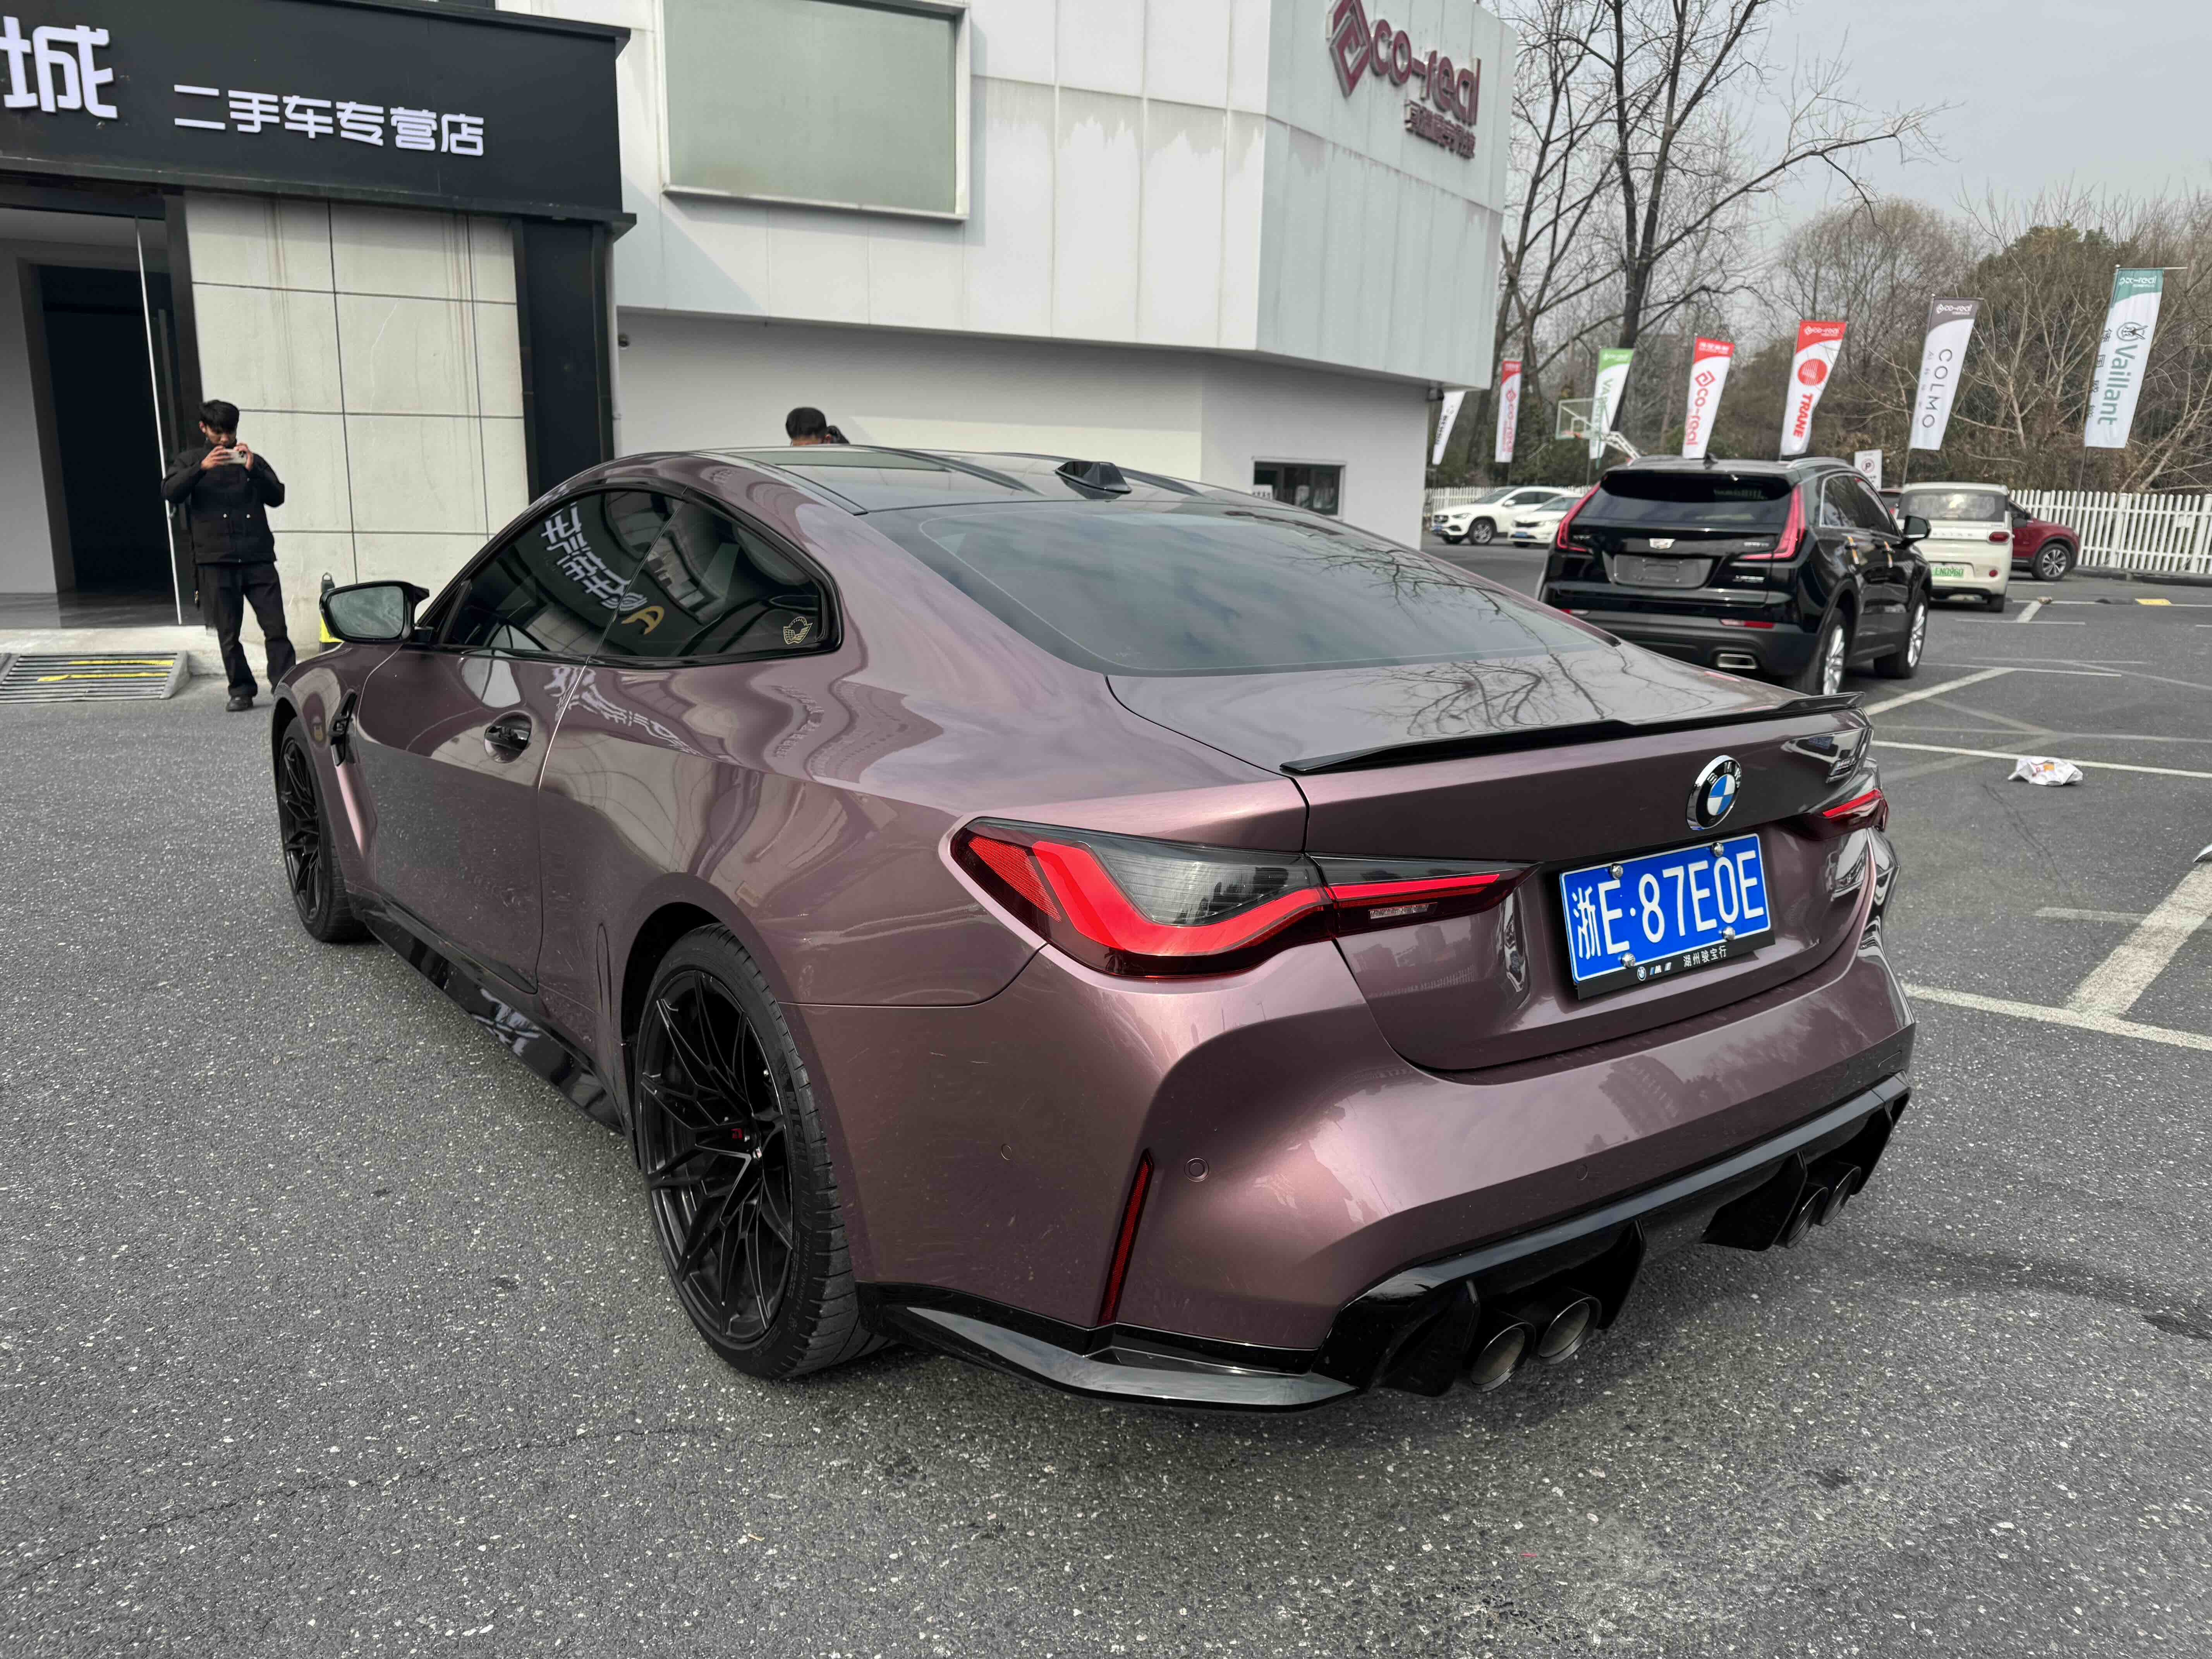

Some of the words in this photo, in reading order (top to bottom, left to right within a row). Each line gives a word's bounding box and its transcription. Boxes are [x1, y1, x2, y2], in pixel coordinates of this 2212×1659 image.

[0, 16, 119, 119] 城
[1371, 19, 1482, 126] co-real
[173, 84, 485, 157] 二手车专营店
[1685, 388, 1709, 445] co-real
[1793, 393, 1814, 438] TRANE
[1922, 349, 1953, 428] COLMO
[2097, 345, 2138, 425] Vaillant
[1571, 850, 1764, 960] 浙E·87E0E
[1683, 945, 1727, 967] 湖州骏宝行
